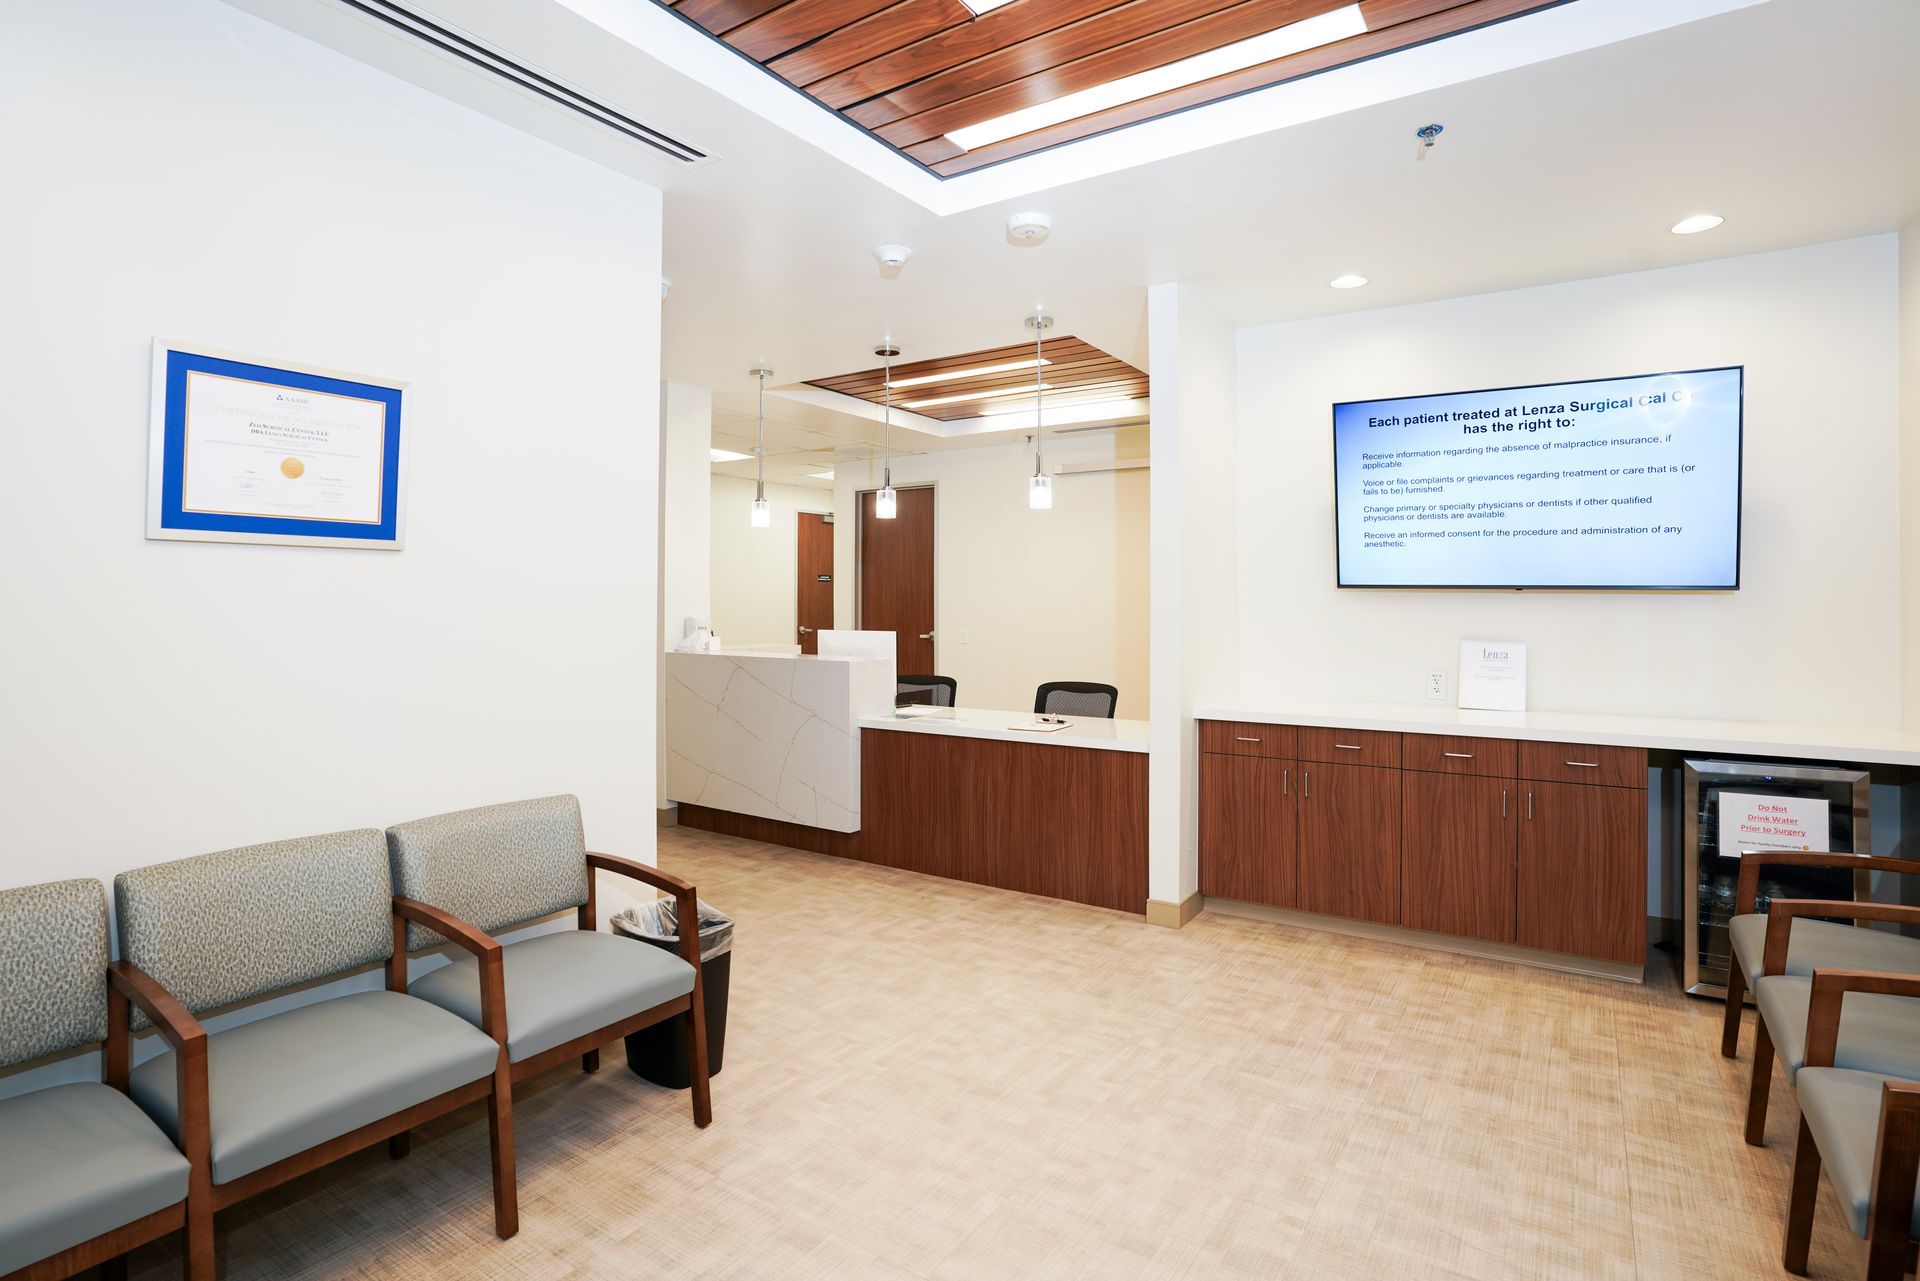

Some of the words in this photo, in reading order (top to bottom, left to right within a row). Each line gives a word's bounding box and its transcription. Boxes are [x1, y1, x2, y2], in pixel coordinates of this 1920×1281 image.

[1368, 416, 1400, 428] Each
[1404, 412, 1448, 427] patient
[1452, 408, 1500, 420] treated
[1504, 406, 1518, 417] at
[1522, 404, 1564, 416] Lenza
[1570, 397, 1633, 412] Surgical
[1463, 424, 1488, 434] has
[1492, 421, 1514, 432] the
[1518, 418, 1552, 432] right
[1556, 418, 1575, 428] to:
[1396, 450, 1440, 458] information
[1444, 446, 1483, 456] regarding
[1486, 445, 1500, 453] the
[1502, 444, 1540, 452] absence
[1542, 442, 1552, 450] of
[1554, 438, 1608, 450] malpractice
[1610, 436, 1662, 446] insurance,
[1665, 434, 1672, 442] if
[1410, 475, 1454, 486] complaints
[1468, 472, 1514, 483] grievances
[1516, 471, 1560, 482] regarding
[1562, 468, 1607, 478] treatment
[1648, 465, 1666, 474] that
[1670, 464, 1678, 472] is
[1681, 464, 1696, 474] (or
[1364, 506, 1394, 514] Change
[1396, 504, 1426, 514] primary
[1439, 502, 1475, 512] specialty
[1478, 500, 1524, 510] physicians
[1538, 498, 1573, 508] dentists
[1576, 498, 1582, 506] if
[1584, 497, 1608, 506] other
[1610, 496, 1652, 506] qualified
[1364, 514, 1404, 522] physicians
[1466, 510, 1508, 519] available.
[1410, 530, 1446, 538] informed
[1448, 530, 1480, 538] consent
[1512, 528, 1558, 538] procedure
[1560, 527, 1578, 536] and
[1581, 526, 1648, 535] administration
[1651, 525, 1661, 534] of
[1664, 525, 1682, 535] any
[1748, 814, 1770, 822] Drink
[1772, 816, 1798, 824] Water
[1740, 824, 1760, 832] Prior
[1774, 828, 1806, 838] Surgery
